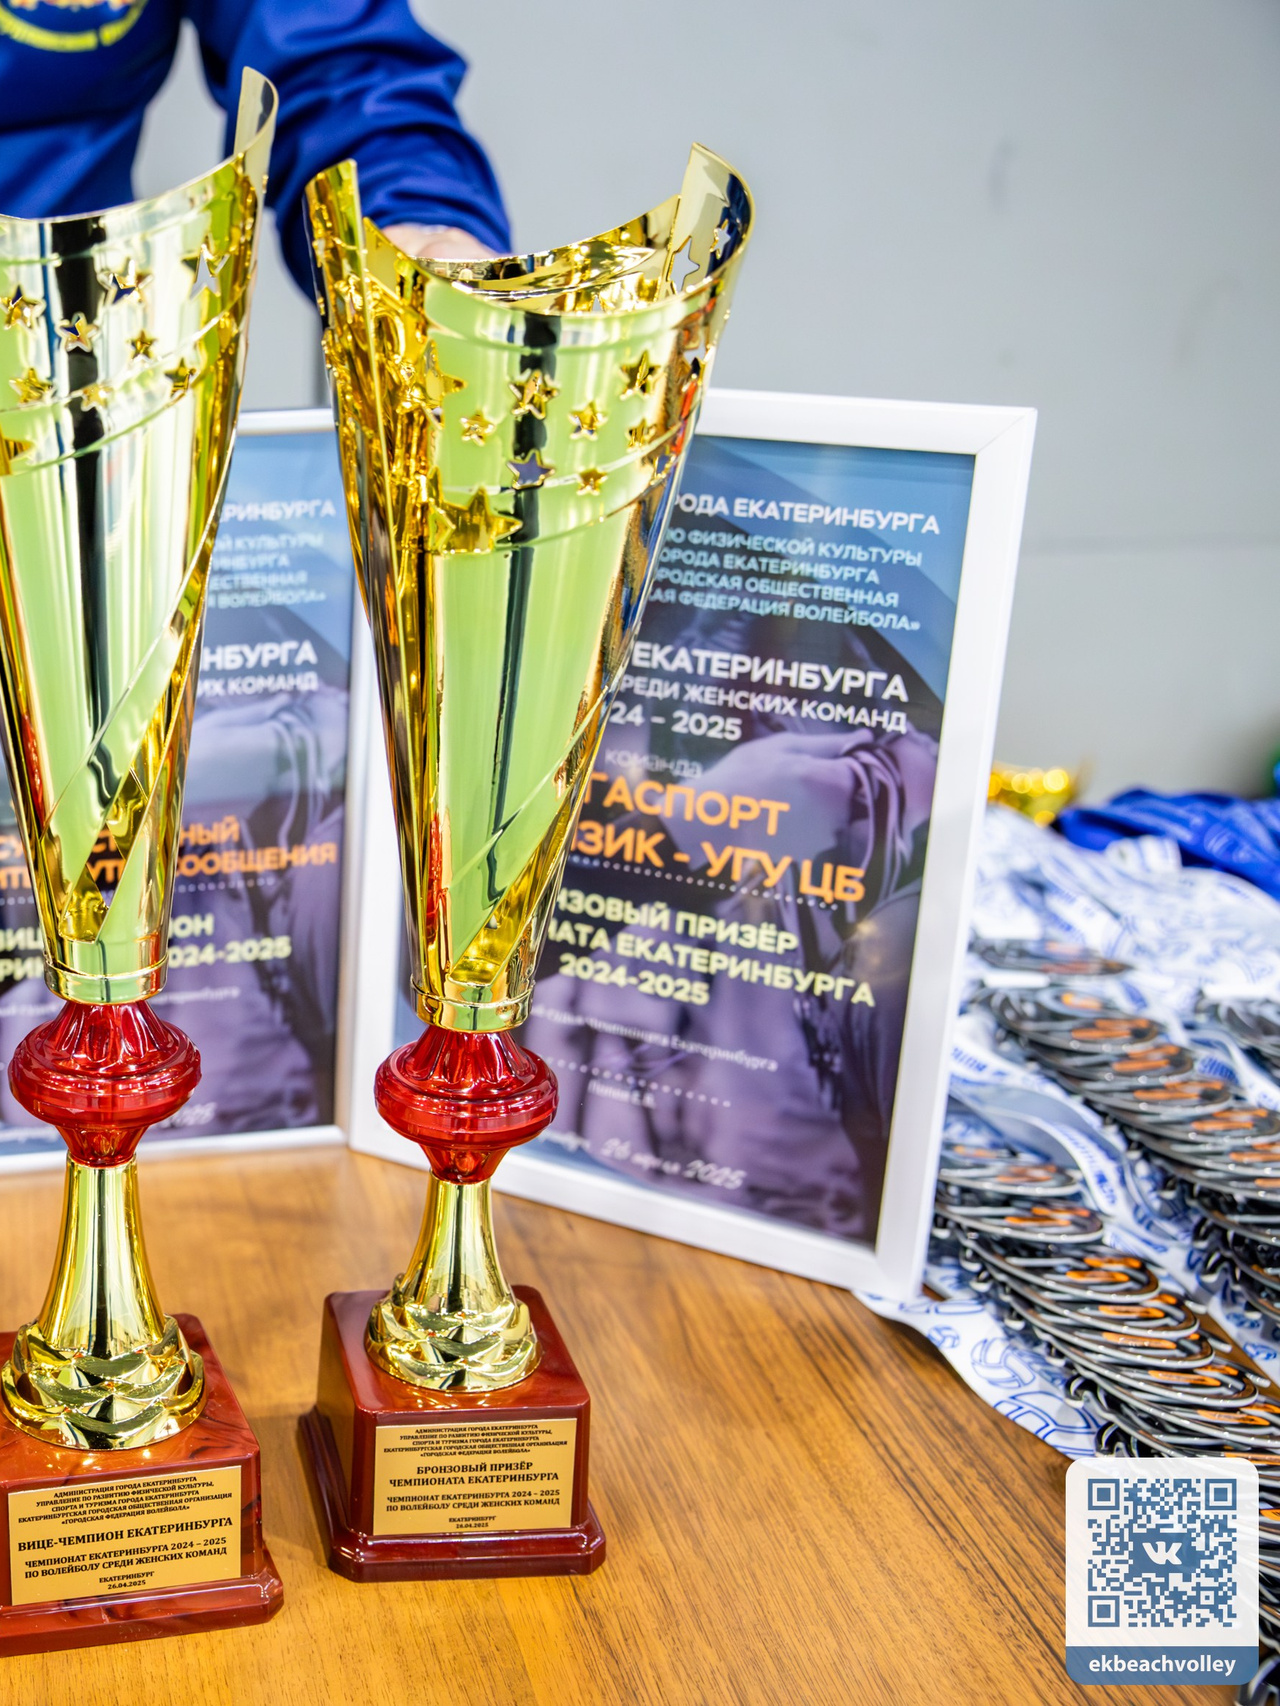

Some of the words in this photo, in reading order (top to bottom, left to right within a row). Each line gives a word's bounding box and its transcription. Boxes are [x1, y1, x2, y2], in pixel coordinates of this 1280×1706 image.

[221, 500, 336, 522] РИНБУРГА
[673, 494, 728, 517] ОДА
[734, 498, 940, 535] ЕКАТЕРИНБУРГА
[688, 530, 814, 556] ФИЗИЧЕСКОЙ
[818, 543, 922, 567] КУЛЬТУРЫ
[660, 550, 719, 569] ОРОДА
[723, 554, 880, 585] ЕКАТЕРИНБУРГА
[654, 568, 742, 590] РОДСКАЯ
[746, 578, 898, 608] ОБЩЕСТВЕННАЯ
[679, 591, 789, 618] ФЕДЕРАЦИЯ
[793, 600, 920, 631] ВОЛЕЙБОЛА»
[632, 642, 908, 702] ЕКАТЕРИНБУРГА
[609, 702, 645, 727] 24
[671, 711, 742, 741] 2025
[621, 678, 679, 699] РЕДИ
[683, 683, 796, 714] ЖЕНСКИХ
[801, 700, 907, 733] КОМАНД
[583, 771, 791, 836] ГАСПОРТ
[701, 841, 793, 888] УГУ
[799, 860, 865, 903] ЦБ
[558, 887, 671, 931] ЗОВЫЙ
[676, 911, 799, 956] ПРИЗЁР
[169, 936, 292, 968] 024-2025
[559, 953, 710, 1006] 2024-2025
[616, 932, 875, 1006] ЕКАТЕРИНБУРГА
[389, 1476, 466, 1487] ЧЕМПИОНАТА
[468, 1472, 559, 1484] ЕКАТЕРИНБУРГА
[416, 1462, 487, 1475] БРОНЗОВЫЙ
[490, 1461, 533, 1472] ПРИЗЁР
[36, 1497, 80, 1507] УПРАВЛЕНИЕ
[92, 1491, 130, 1500] РАЗВИТИЮ
[130, 1485, 176, 1496] ФИЗИЧЕСКОЙ
[52, 1504, 78, 1512] СПОРТА
[85, 1500, 116, 1508] ТУРИЗМА
[118, 1496, 144, 1505] ГОРОДА
[144, 1490, 200, 1501] ЕКАТЕРИНБУРГА
[54, 1486, 114, 1499] АДМИНИСТРАЦИЯ
[116, 1483, 142, 1491] ГОРОДА
[142, 1476, 198, 1488] ЕКАТЕРИНБУРГА
[387, 1494, 440, 1503] ЧЕМПИОНАТ
[442, 1491, 510, 1501] ЕКАТЕРИНБУРГА
[540, 1489, 560, 1497] 2025
[18, 1510, 87, 1523] ЕКАТЕРИНБУРГСКАЯ
[88, 1505, 127, 1515] ГОРОДСКАЯ
[128, 1498, 183, 1511] ОБЩЕСТВЕННАЯ
[184, 1492, 232, 1504] ОРГАНИЗАЦИЯ
[105, 1510, 145, 1520] ФЕДЕРАЦИЯ
[400, 1502, 450, 1511] ВОЛЕЙБОЛУ
[452, 1501, 480, 1509] СРЕДИ
[480, 1499, 522, 1508] ЖЕНСКИХ
[524, 1498, 560, 1506] КОМАНД
[18, 1530, 124, 1552] ВИЦЕ-ЧЕМПИОН
[127, 1517, 233, 1539] ЕКАТЕРИНБУРГА
[24, 1553, 87, 1568] ЧЕМПИОНАТ
[88, 1544, 169, 1561] ЕКАТЕРИНБУРГА
[170, 1541, 194, 1551] 2024
[204, 1537, 227, 1547] 2025
[24, 1569, 39, 1579] ПО
[41, 1562, 100, 1577] ВОЛЕЙБОЛУ
[102, 1558, 134, 1570] СРЕДИ
[135, 1552, 183, 1566] ЖЕНСКИХ
[185, 1547, 228, 1560] КОМАНД
[99, 1571, 155, 1584] ЕКАТЕРИНБУРГ
[107, 1580, 146, 1590] 26.04.2025
